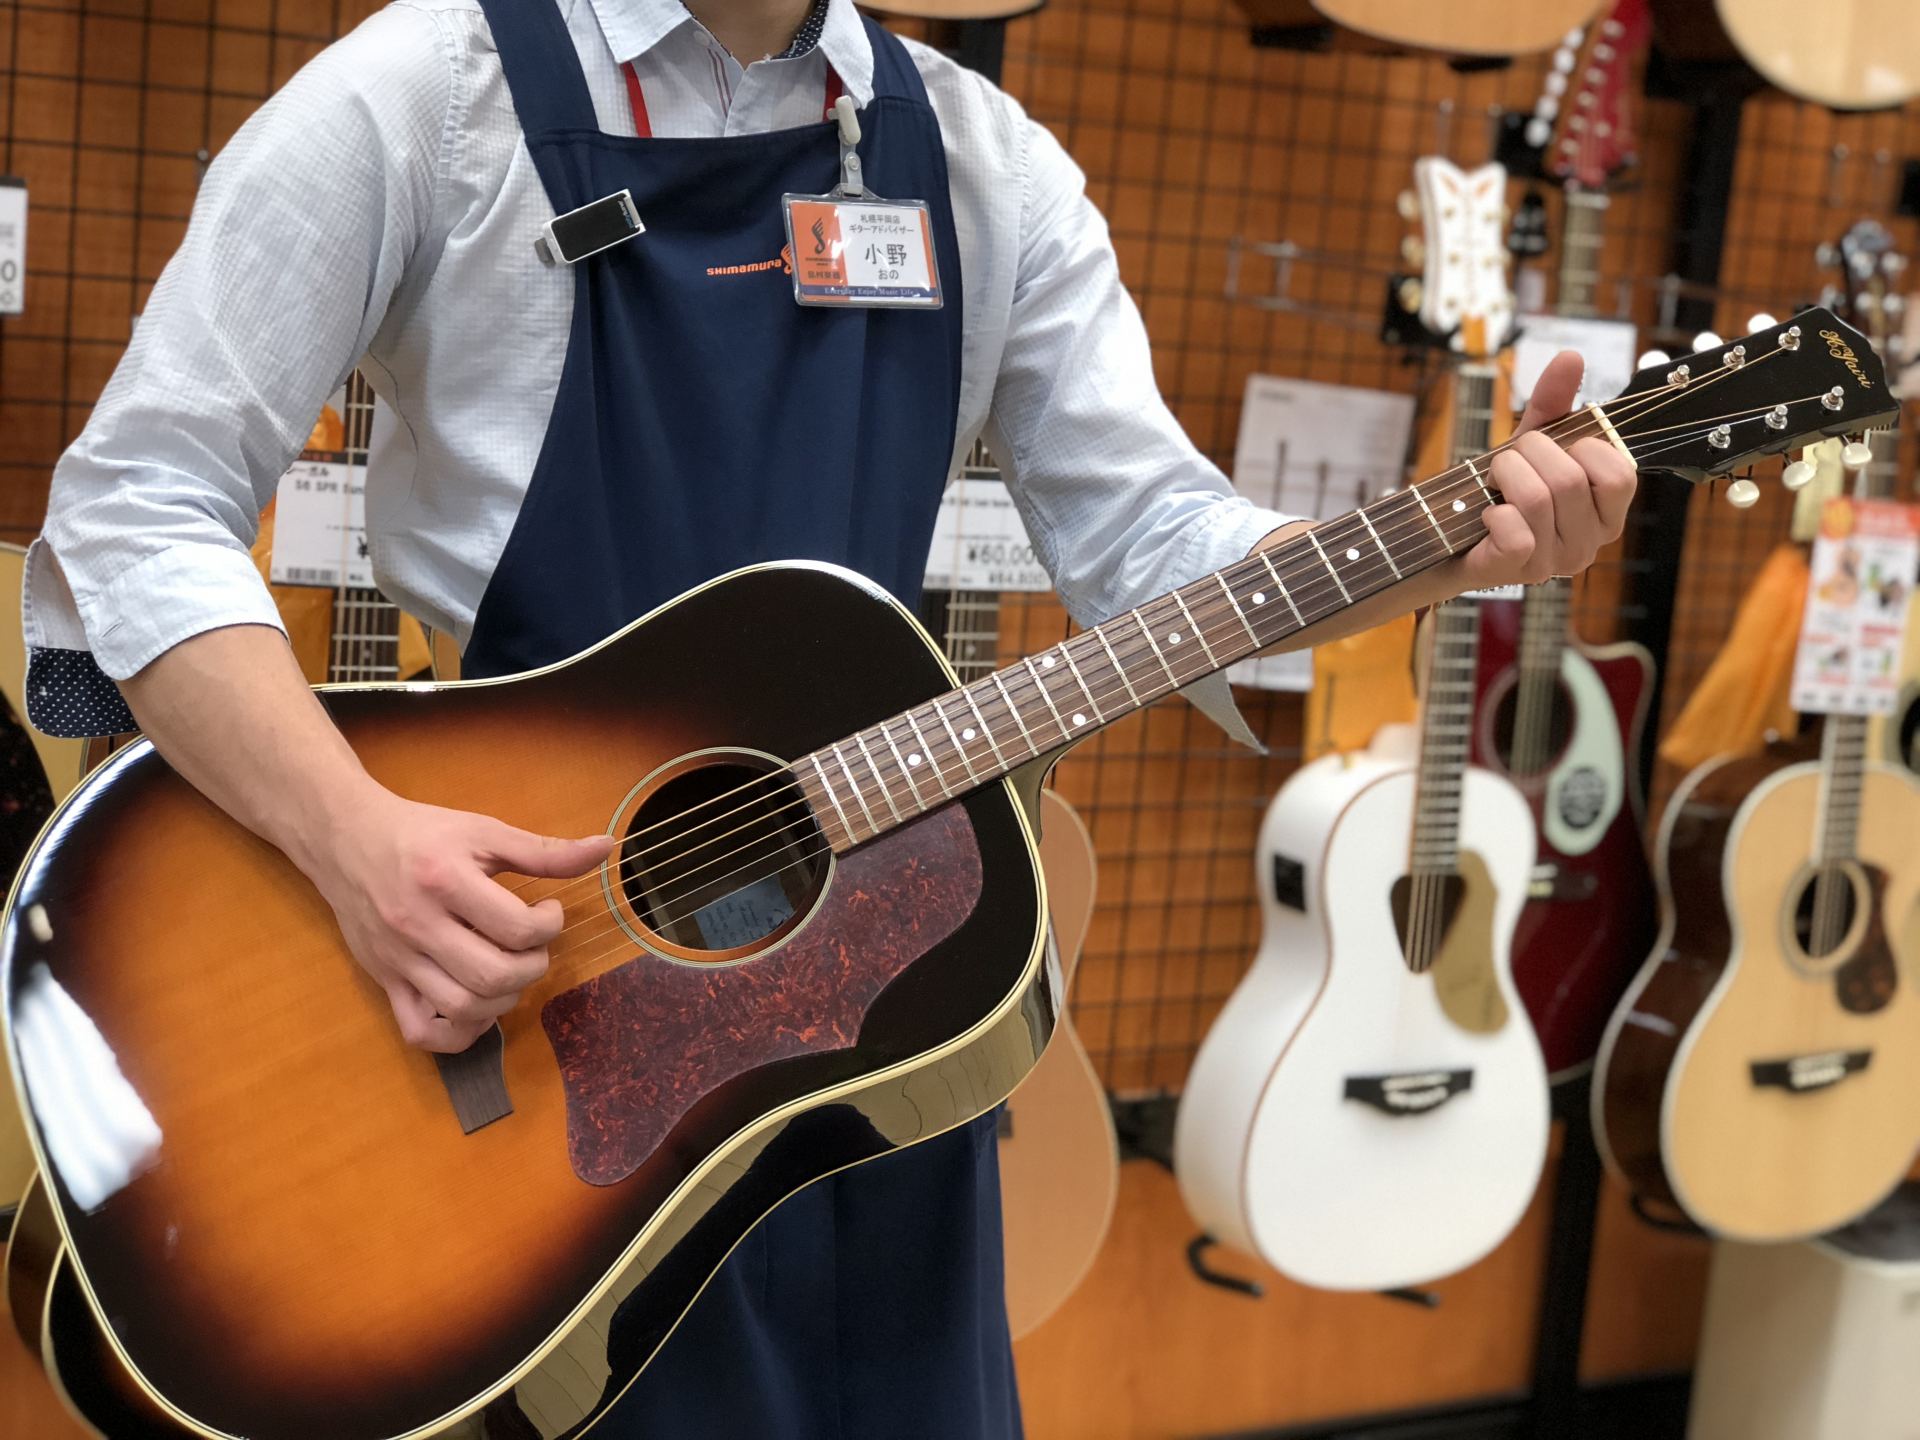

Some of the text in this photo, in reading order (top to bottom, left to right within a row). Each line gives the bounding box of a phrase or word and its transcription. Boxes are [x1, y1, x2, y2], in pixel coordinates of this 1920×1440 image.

[849, 224, 915, 235] ギターアドバイザー
[865, 243, 907, 267] 小野
[878, 268, 900, 280] おの
[857, 287, 879, 297] Enjoy
[879, 287, 898, 296] Music
